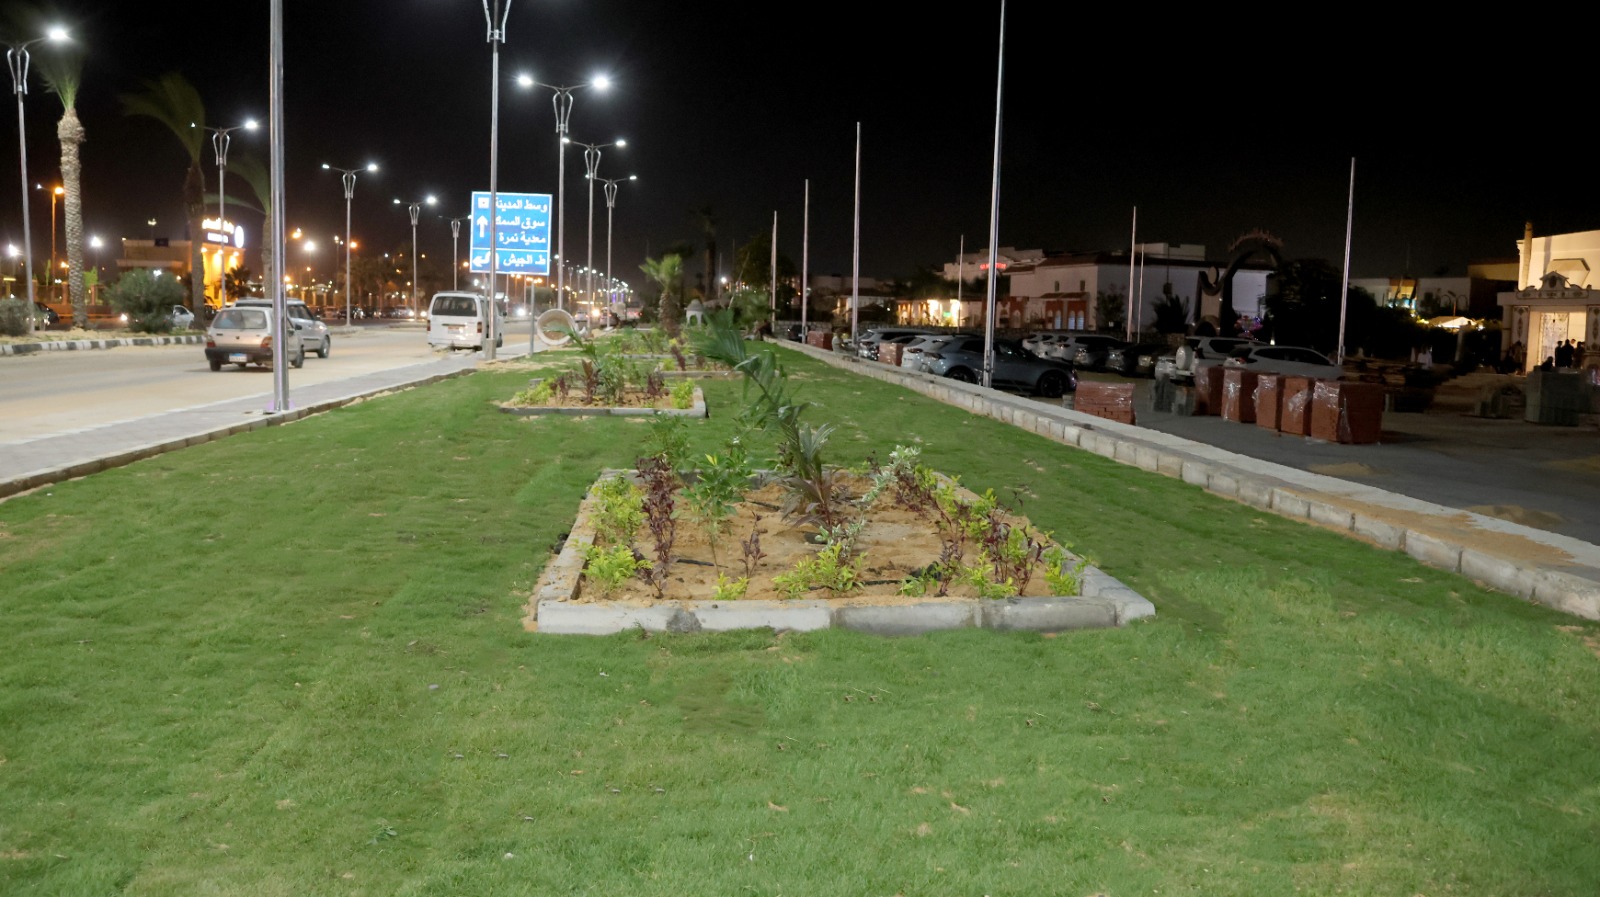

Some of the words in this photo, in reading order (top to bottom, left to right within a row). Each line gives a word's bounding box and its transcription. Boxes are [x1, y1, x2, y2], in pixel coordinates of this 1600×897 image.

[496, 197, 522, 212] المدينة
[524, 199, 547, 213] وسط
[521, 217, 545, 230] سوق
[499, 232, 519, 245] نمرة
[520, 231, 546, 246] معدية
[503, 253, 533, 267] الجيش
